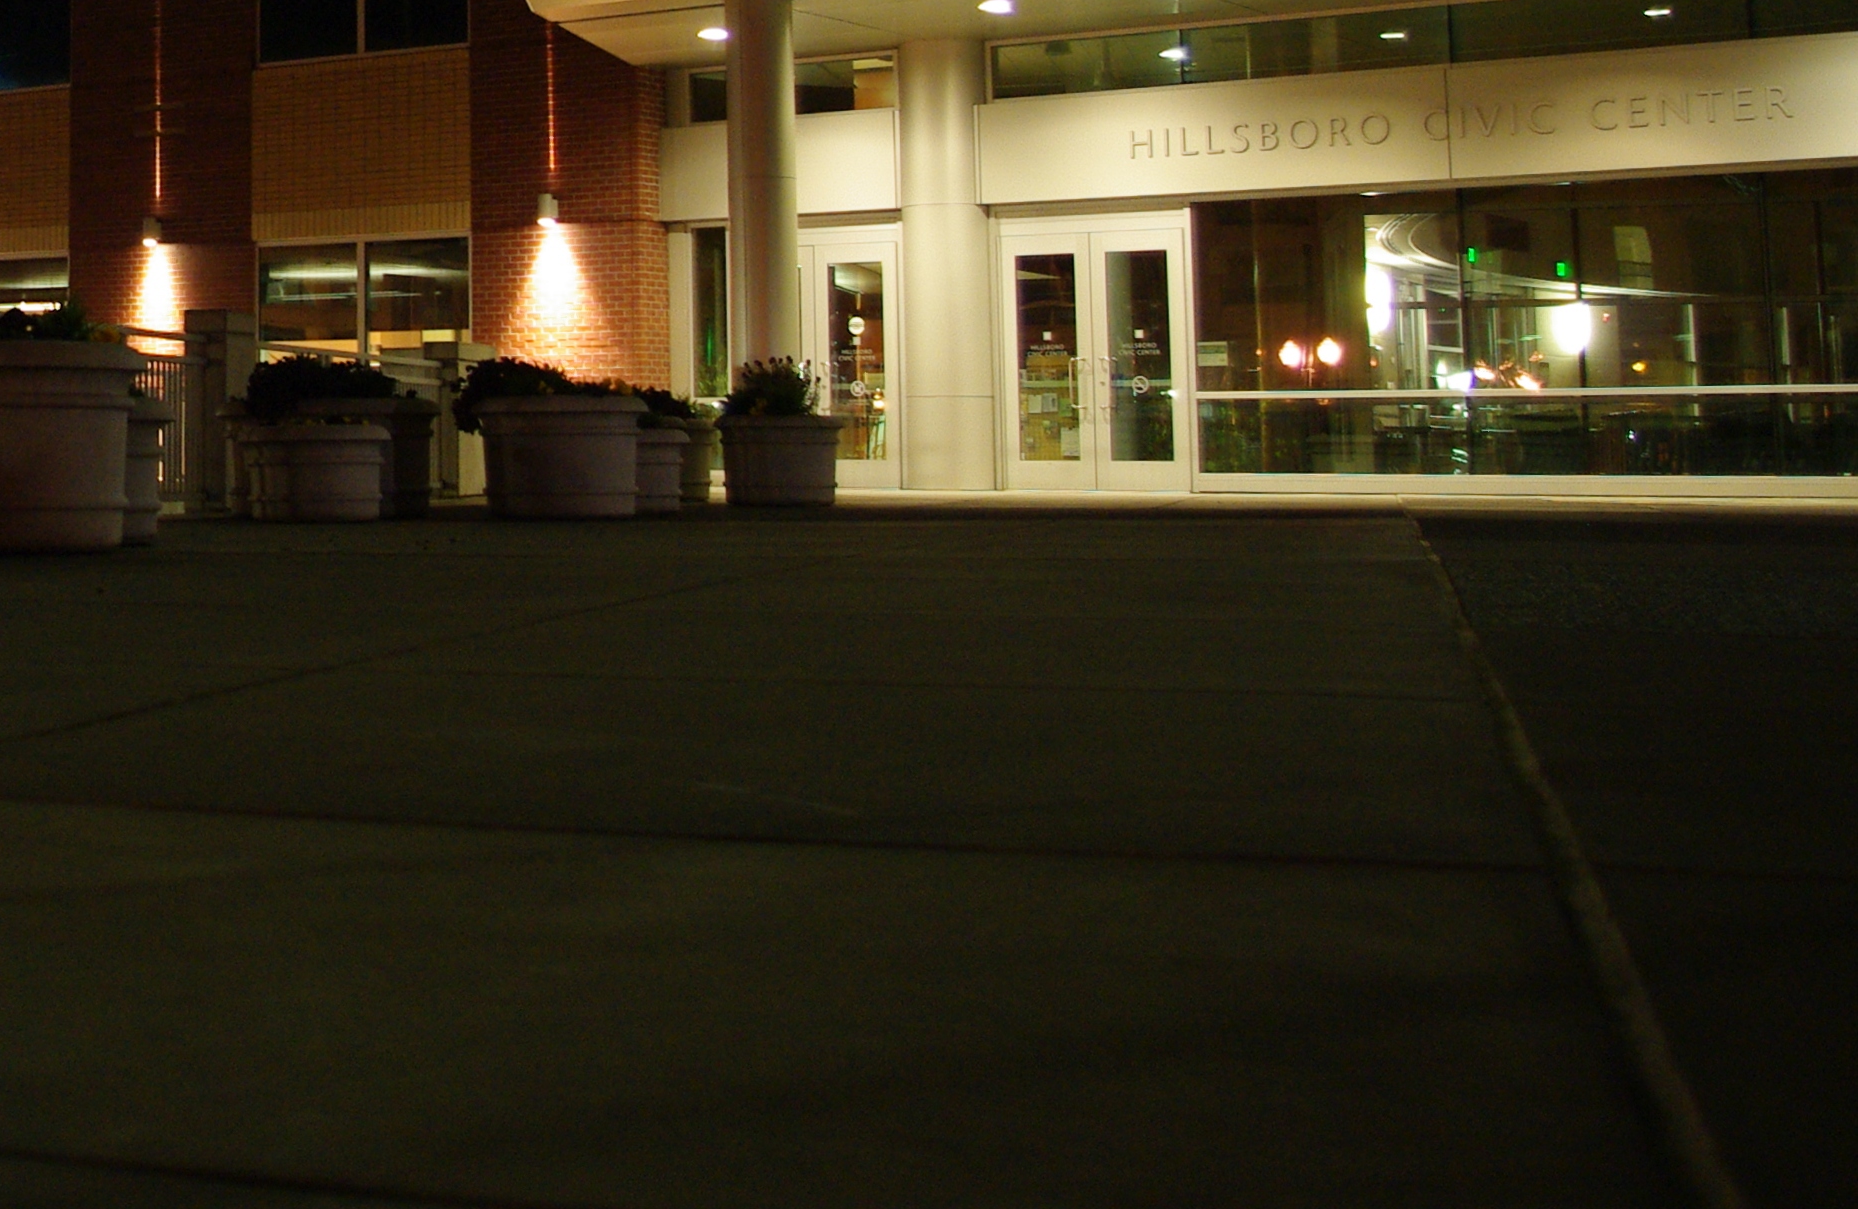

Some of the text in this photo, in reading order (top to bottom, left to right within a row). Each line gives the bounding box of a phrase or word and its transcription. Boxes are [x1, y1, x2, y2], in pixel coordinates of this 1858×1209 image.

[1129, 86, 1794, 160] HILLSBORO CIVIC CENTER
